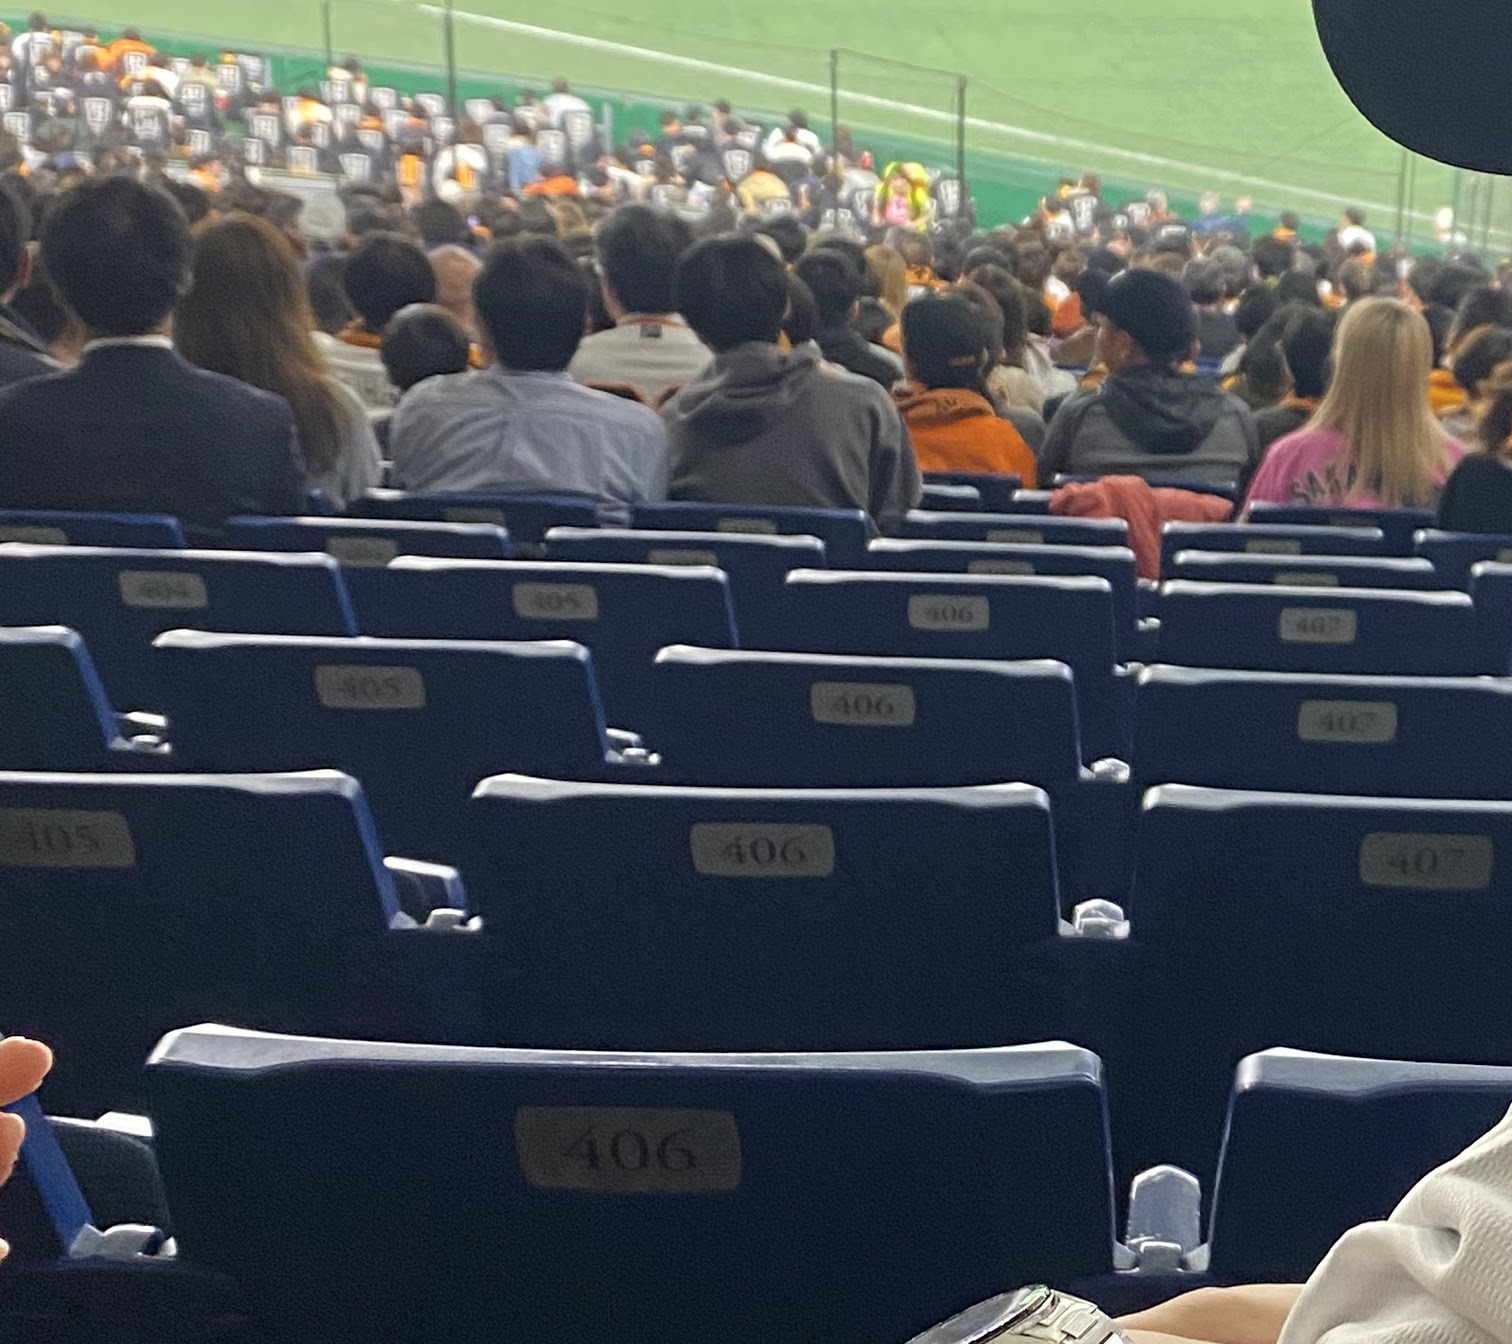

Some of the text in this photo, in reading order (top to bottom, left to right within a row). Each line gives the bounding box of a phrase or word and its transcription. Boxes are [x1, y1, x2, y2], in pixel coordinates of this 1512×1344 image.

[925, 602, 975, 623] 406
[832, 693, 895, 717] 406
[1318, 710, 1378, 732] 407
[721, 836, 808, 869] 406
[1385, 847, 1465, 875] 407
[561, 1125, 699, 1176] 406
